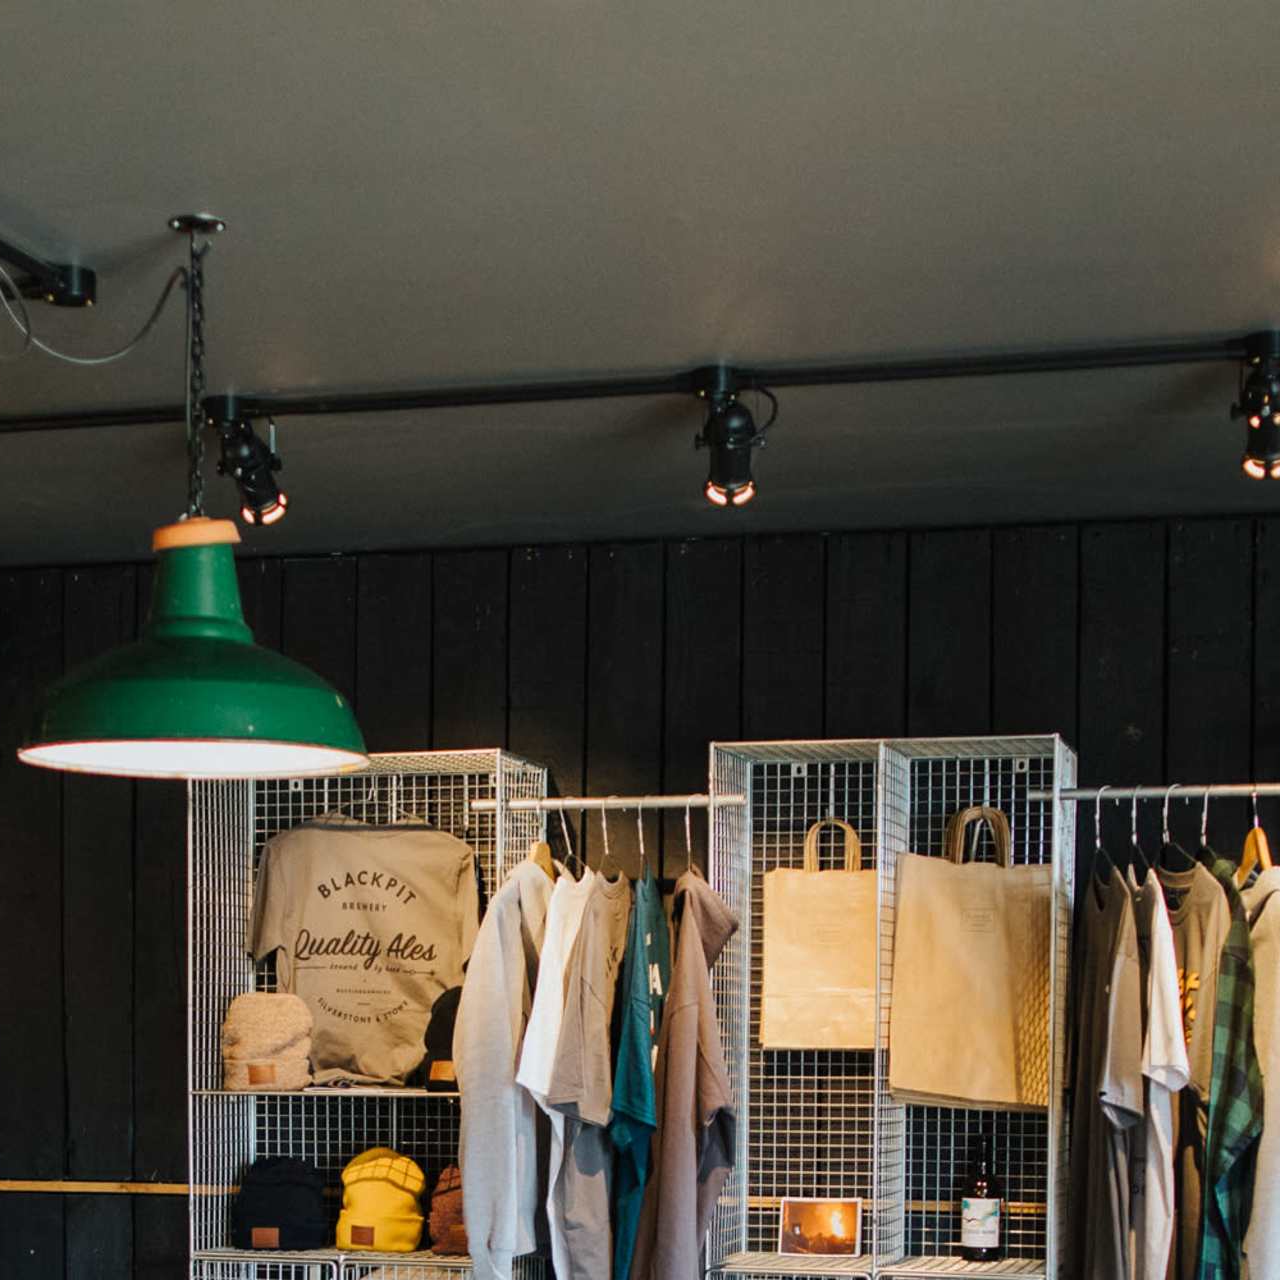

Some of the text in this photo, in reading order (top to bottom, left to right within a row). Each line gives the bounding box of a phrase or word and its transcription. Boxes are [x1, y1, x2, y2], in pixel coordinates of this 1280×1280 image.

[317, 870, 416, 904] BLACKPIT
[342, 902, 387, 912] BREWERY
[295, 929, 437, 970] Quality Ales
